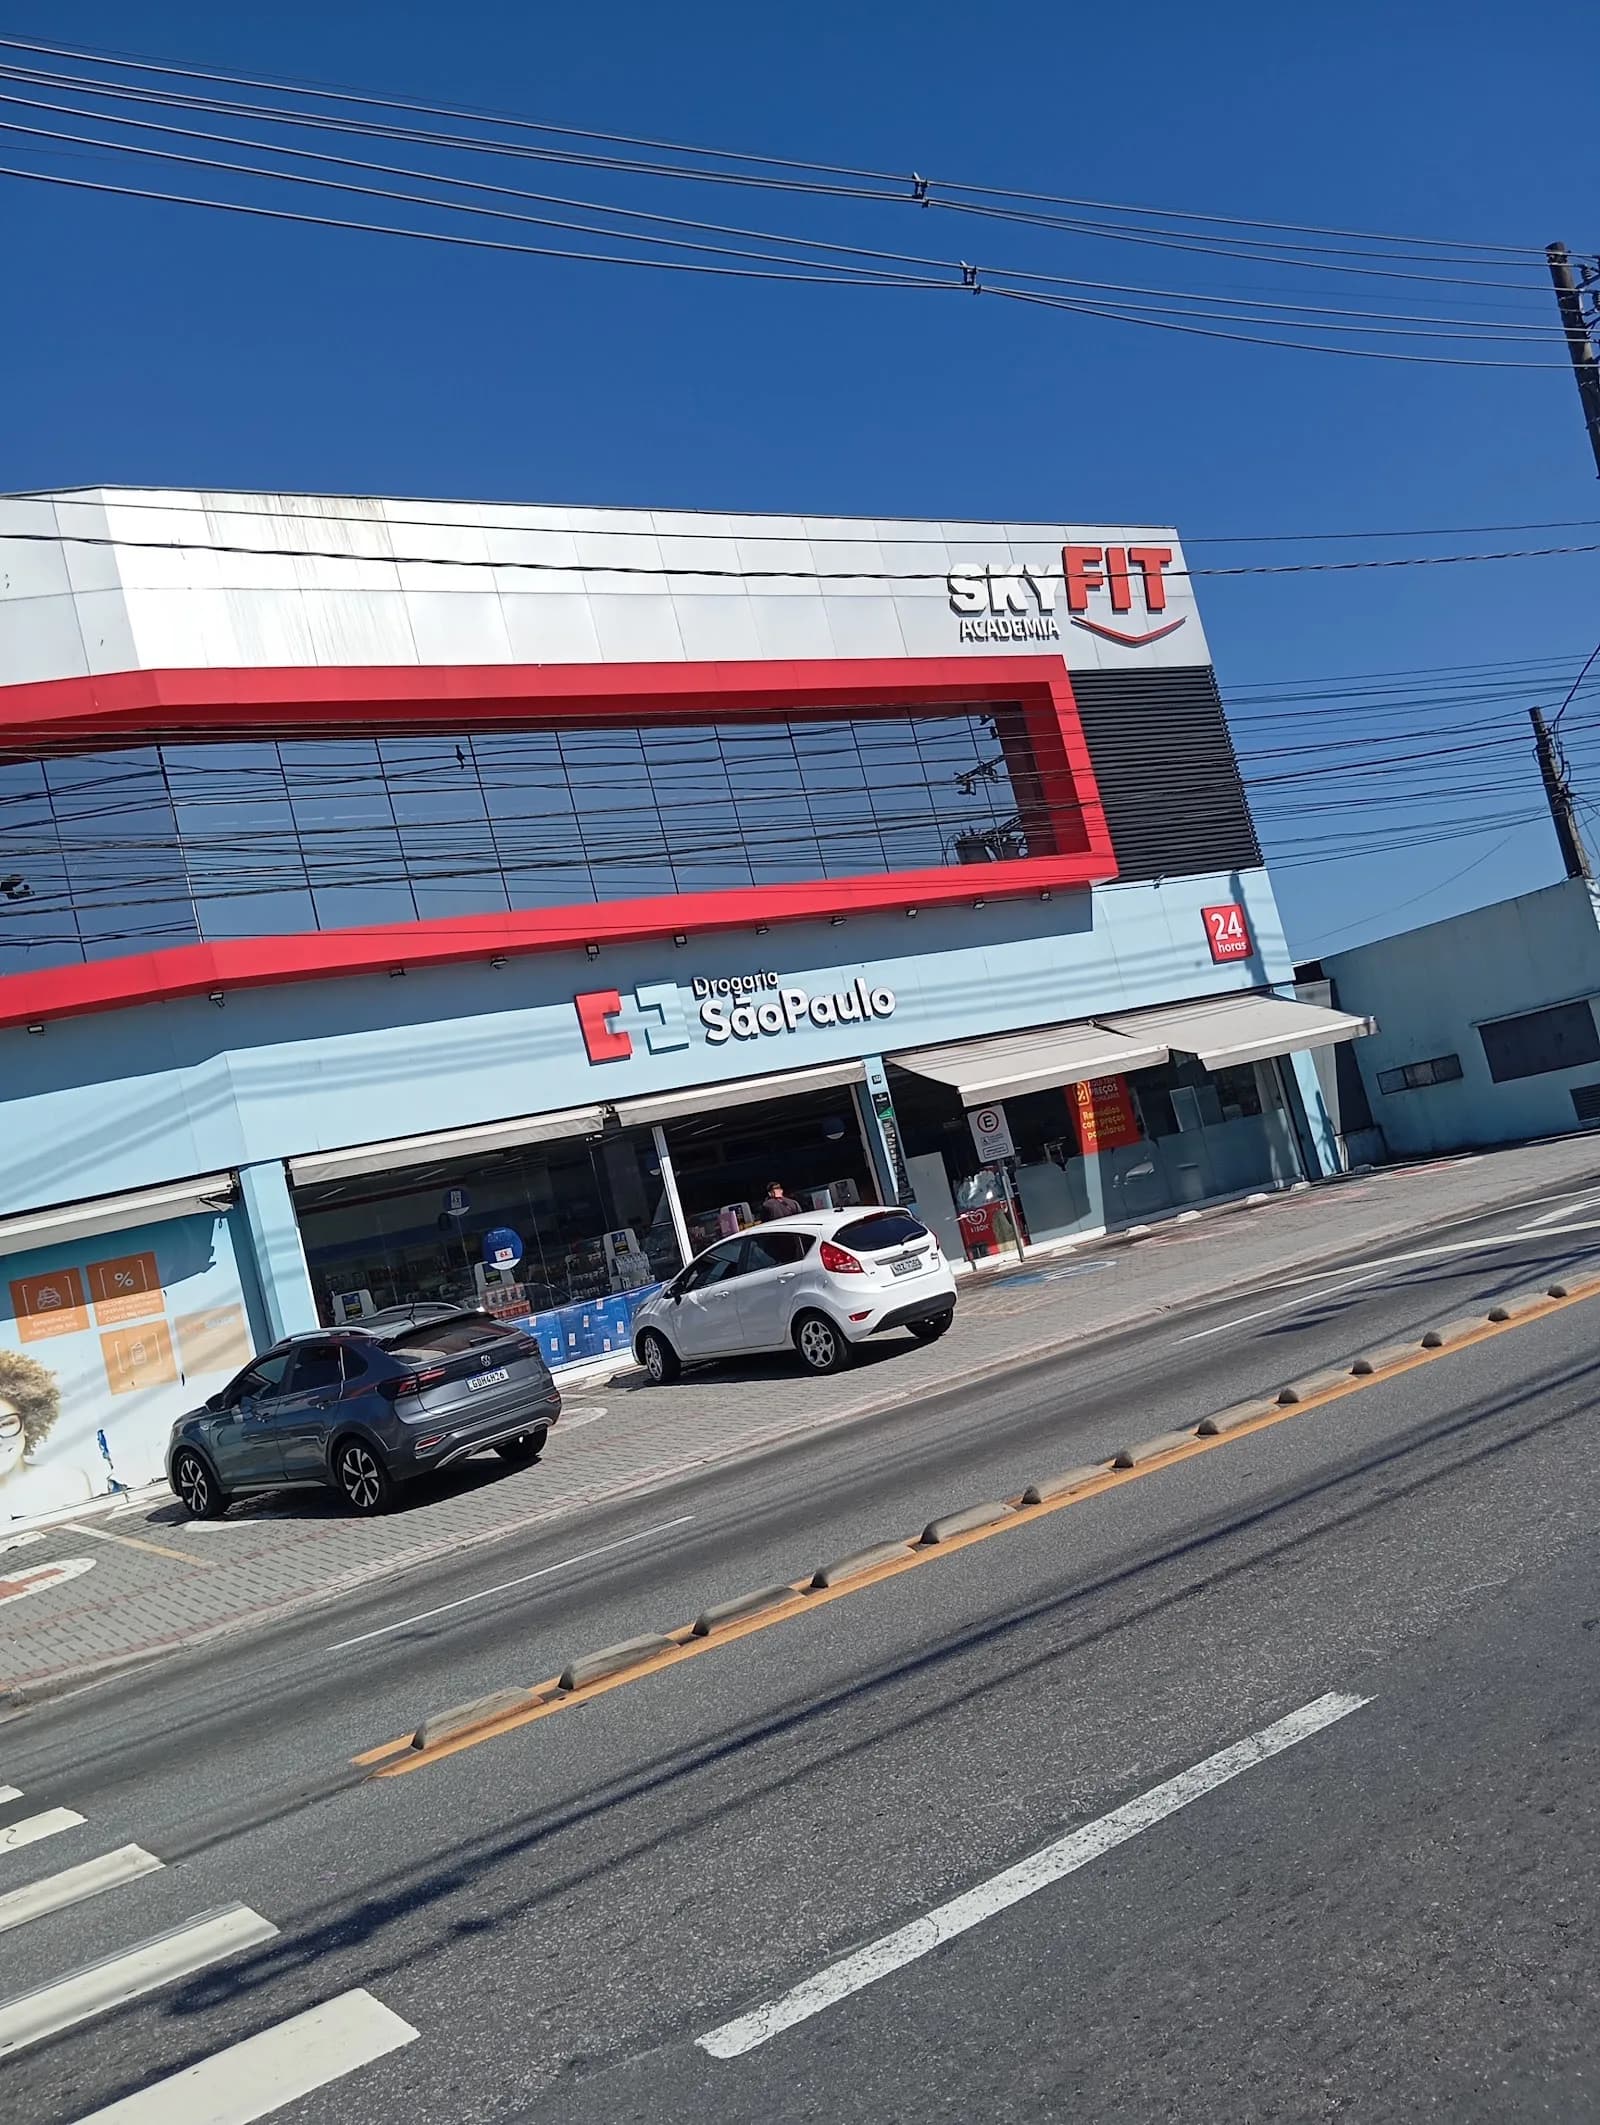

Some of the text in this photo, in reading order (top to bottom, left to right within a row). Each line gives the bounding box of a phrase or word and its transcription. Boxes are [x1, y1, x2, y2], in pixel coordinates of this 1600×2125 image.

[960, 616, 1060, 642] ACADEMIA
[1210, 911, 1243, 940] 24
[1217, 941, 1247, 954] horas
[692, 969, 779, 1000] Drogaria
[983, 1115, 994, 1128] E
